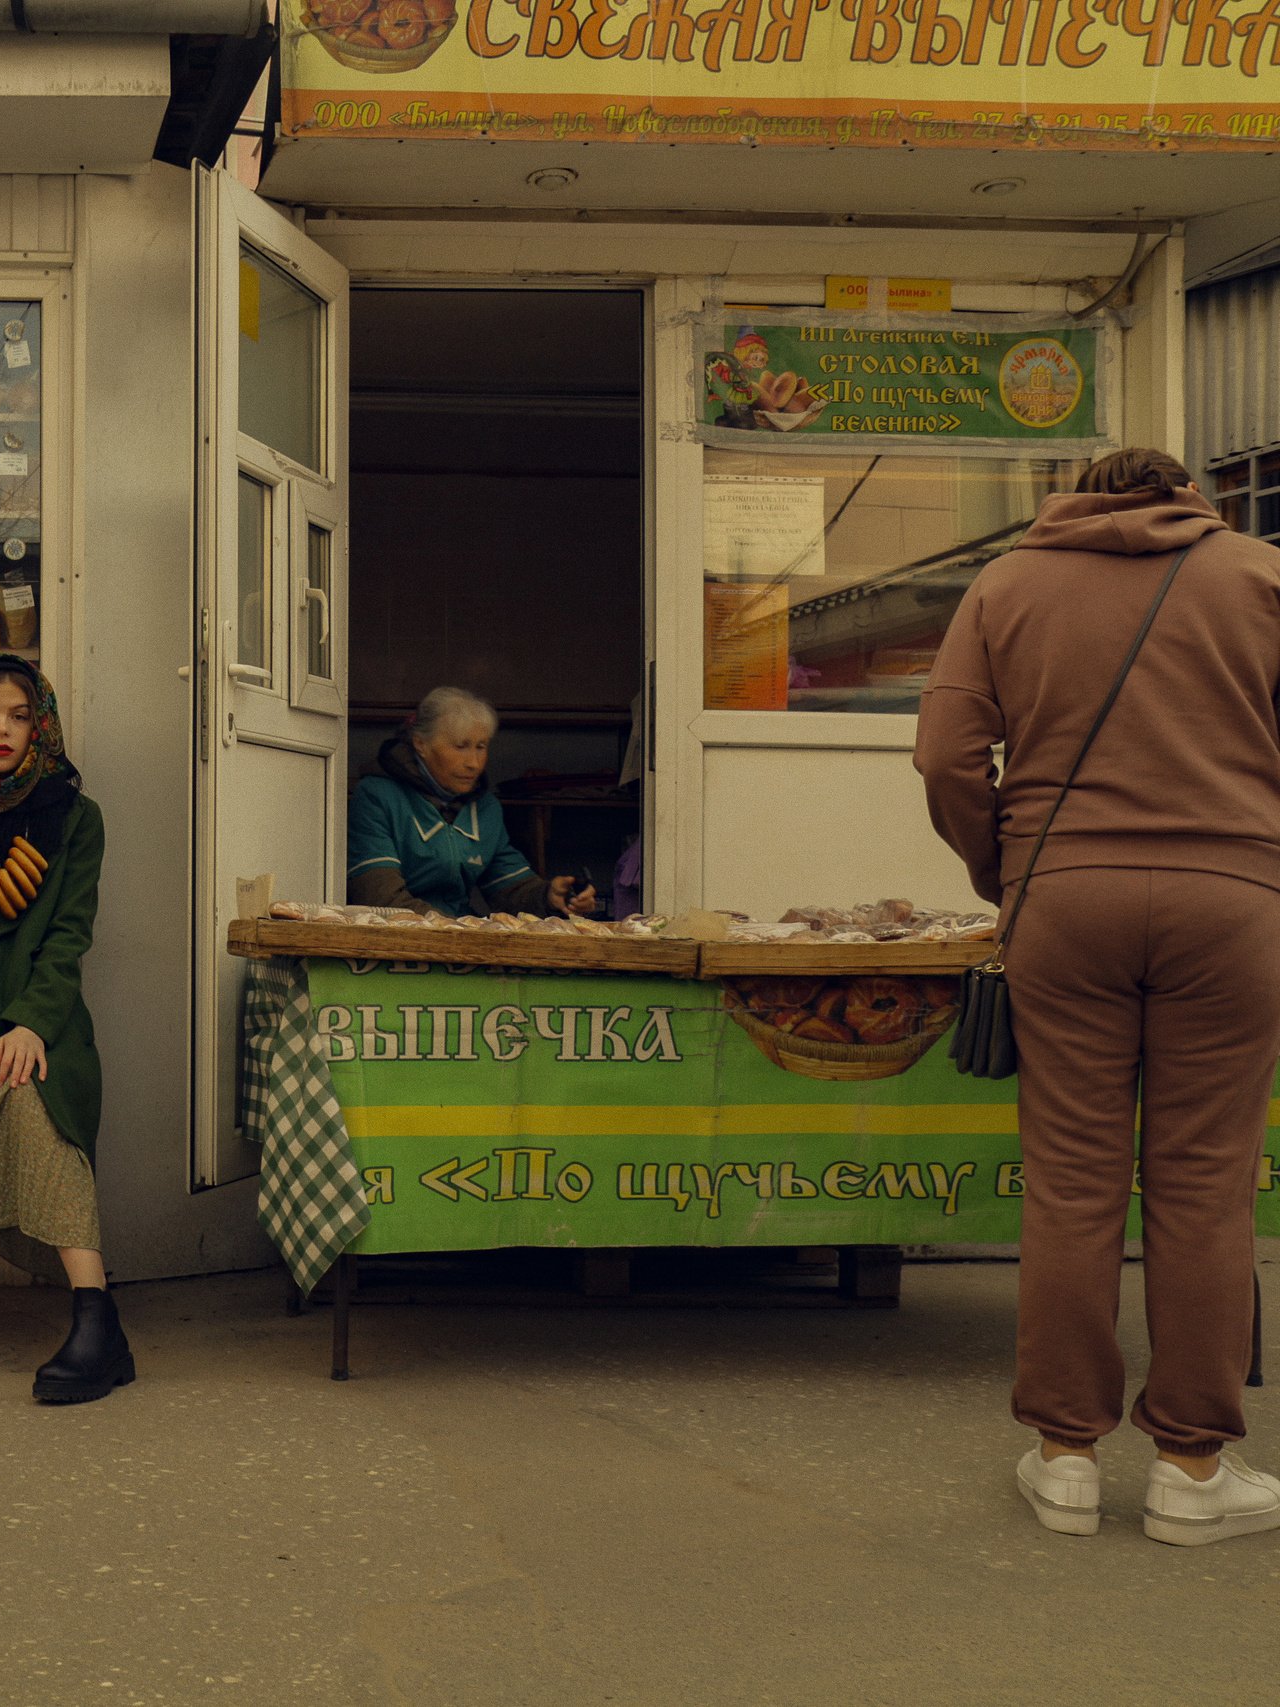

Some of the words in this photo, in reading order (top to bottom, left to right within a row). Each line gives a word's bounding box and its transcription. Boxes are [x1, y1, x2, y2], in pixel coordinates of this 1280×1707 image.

[466, 0, 831, 72] СВЕЖАЯ
[841, 0, 1280, 77] ВЫПЕЧКА
[313, 100, 381, 128] ООО
[552, 112, 594, 139] ул.
[1096, 113, 1219, 145] 2552-76,
[1227, 112, 1280, 141] ИН
[798, 326, 836, 343] ИП
[842, 328, 946, 345] Агейкина
[819, 353, 980, 376] СТОЛОВАЯ
[806, 378, 865, 405] «По
[870, 386, 990, 412] щучьему
[831, 413, 962, 433] велению»
[317, 1004, 683, 1063] ВЫПЕЧКА
[419, 1147, 594, 1203] «По
[616, 1161, 977, 1219] щучьему
